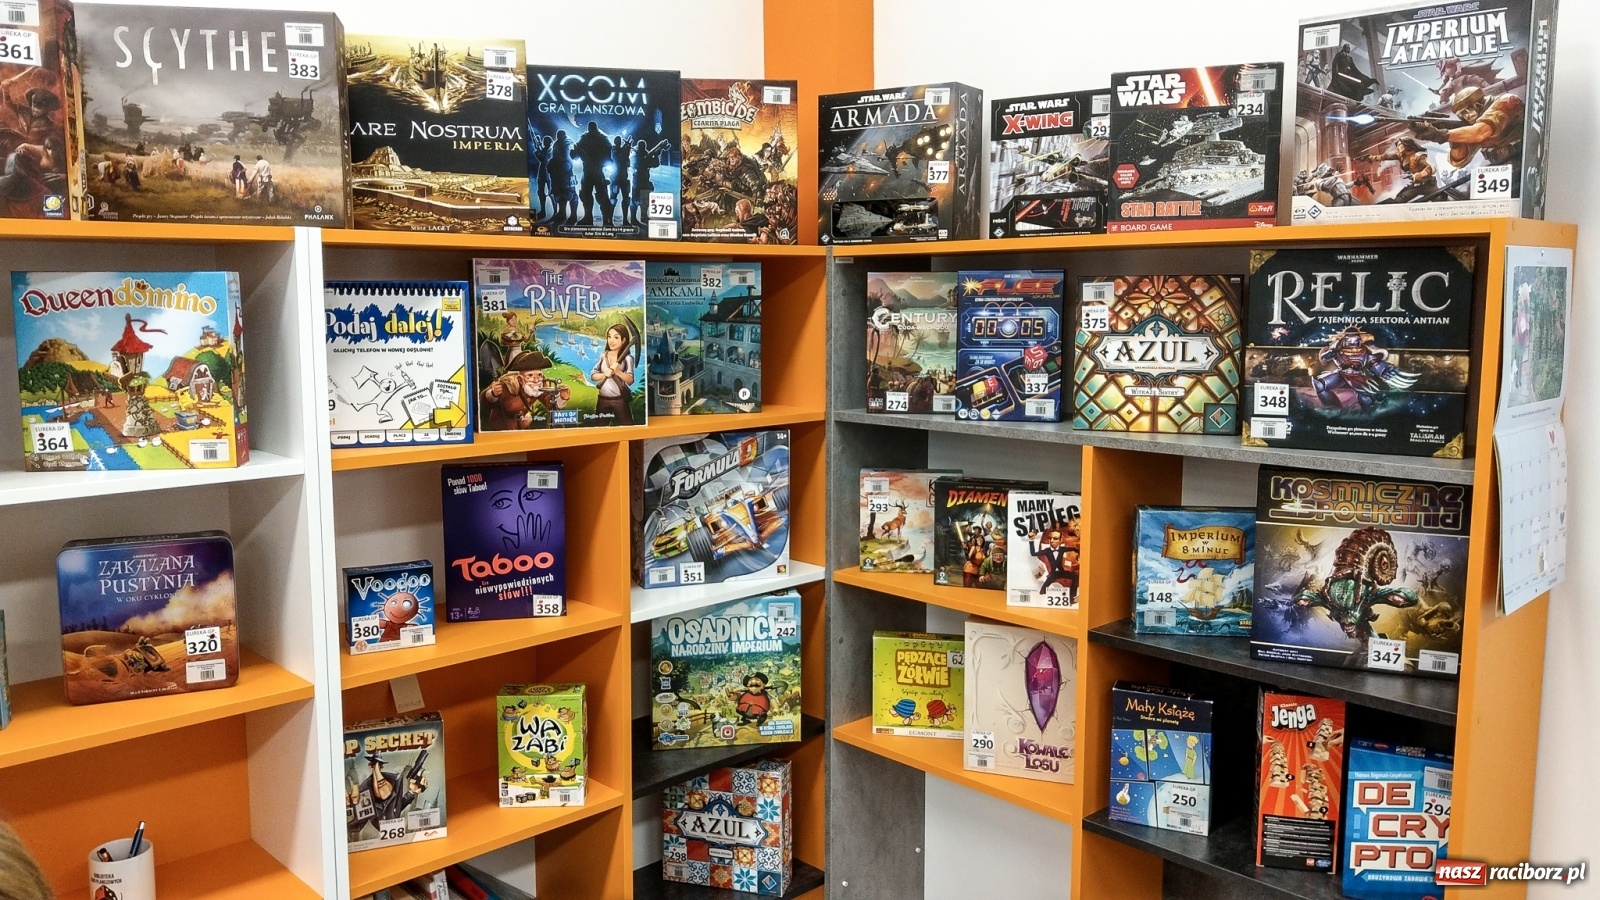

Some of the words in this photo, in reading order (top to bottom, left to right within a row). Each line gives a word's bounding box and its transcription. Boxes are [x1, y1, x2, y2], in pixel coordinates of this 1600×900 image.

[1414, 8, 1446, 19] STAR
[1447, 2, 1480, 13] WARS
[1382, 12, 1510, 58] IMPERIUM
[0, 43, 34, 60] 361
[115, 26, 279, 85] SCYTHE
[1392, 34, 1500, 65] ATAKUJE
[290, 63, 319, 79] 383
[537, 73, 648, 105] XCOM
[1117, 73, 1186, 92] STAR
[487, 84, 512, 98] 378
[857, 94, 886, 103] STAR
[886, 92, 907, 101] WARS
[1117, 88, 1186, 107] WARS
[538, 102, 566, 114] GRA
[570, 103, 646, 116] PLANSZOWA
[1005, 101, 1037, 112] STAR
[1037, 98, 1070, 109] WARS
[1238, 103, 1264, 116] 234
[830, 103, 938, 130] ARMADA
[1002, 111, 1075, 135] X-WING
[350, 123, 397, 136] ARE
[410, 121, 523, 140] NOSTRUM
[1093, 125, 1110, 137] 29
[453, 140, 524, 152] IMPERIA
[929, 170, 948, 181] 377
[1477, 178, 1510, 194] 349
[651, 203, 672, 216] 379
[1121, 202, 1154, 218] STAR
[1156, 201, 1202, 216] BATTLE
[1150, 223, 1173, 231] GAME
[541, 269, 564, 286] THE
[702, 278, 722, 288] 382
[978, 277, 1060, 295] FUSE
[20, 277, 218, 317] Queendomino
[523, 284, 602, 320] RIVER
[1267, 270, 1452, 325] RELIC
[483, 300, 507, 312] 381
[325, 312, 377, 343] Podaj
[385, 309, 442, 342] dalej!
[870, 307, 957, 331] CENTURY
[1084, 318, 1107, 329] 375
[1318, 316, 1367, 324] TAJEMNICA
[1370, 316, 1410, 324] SEKTORA
[1413, 317, 1450, 325] ANTIAN
[1114, 341, 1199, 363] AZUL
[1027, 383, 1048, 393] 337
[1158, 388, 1179, 396] SINTRY
[888, 401, 907, 411] 274
[1260, 396, 1287, 408] 348
[37, 437, 68, 451] 364
[447, 477, 466, 487] Ponad
[466, 474, 483, 484] 1000
[669, 451, 739, 500] FORMULA
[453, 485, 467, 495] słów
[468, 482, 488, 491] Taboo!
[1271, 476, 1464, 510] KOSMICZNE
[947, 489, 1008, 508] DIAMEN
[1017, 498, 1055, 513] MAMY
[869, 503, 888, 513] 293
[1170, 531, 1241, 542] IMPERIUM
[1182, 545, 1189, 554] 8
[1192, 546, 1230, 555] MINUT
[98, 555, 196, 578] ZAKAZANA
[451, 551, 555, 582] Taboo
[100, 572, 195, 595] PUSTYNIA
[475, 573, 554, 595] niewypowiedzianych
[683, 572, 703, 582] 351
[351, 573, 432, 600] Voodoo
[498, 585, 533, 601] słów!!!
[1047, 596, 1069, 606] 328
[1149, 592, 1173, 603] 148
[450, 611, 463, 620] 13+
[536, 604, 559, 614] 358
[354, 624, 380, 638] 380
[777, 627, 796, 637] 242
[187, 639, 218, 654] 320
[671, 642, 729, 658] NARODZINY
[732, 640, 783, 653] IMPERIUM
[896, 651, 947, 667] PĘDZĄCE
[1372, 651, 1401, 665] 347
[897, 663, 949, 686] ŻÓŁWIE
[1125, 697, 1155, 717] Mały
[1158, 701, 1196, 721] Książę
[1270, 703, 1317, 731] Jenga
[519, 715, 562, 738] WA
[364, 732, 438, 753] SECRET
[512, 736, 567, 754] ZABI
[972, 738, 994, 750] 290
[1017, 738, 1070, 758] KOWALE
[1024, 754, 1060, 773] LOSU
[1172, 793, 1197, 807] 250
[1357, 782, 1412, 806] DE
[358, 809, 373, 817] FBI
[380, 828, 405, 840] 268
[691, 816, 750, 839] AZUL
[1372, 814, 1450, 839] CRY
[669, 851, 687, 861] 298
[1354, 844, 1435, 869] PTO
